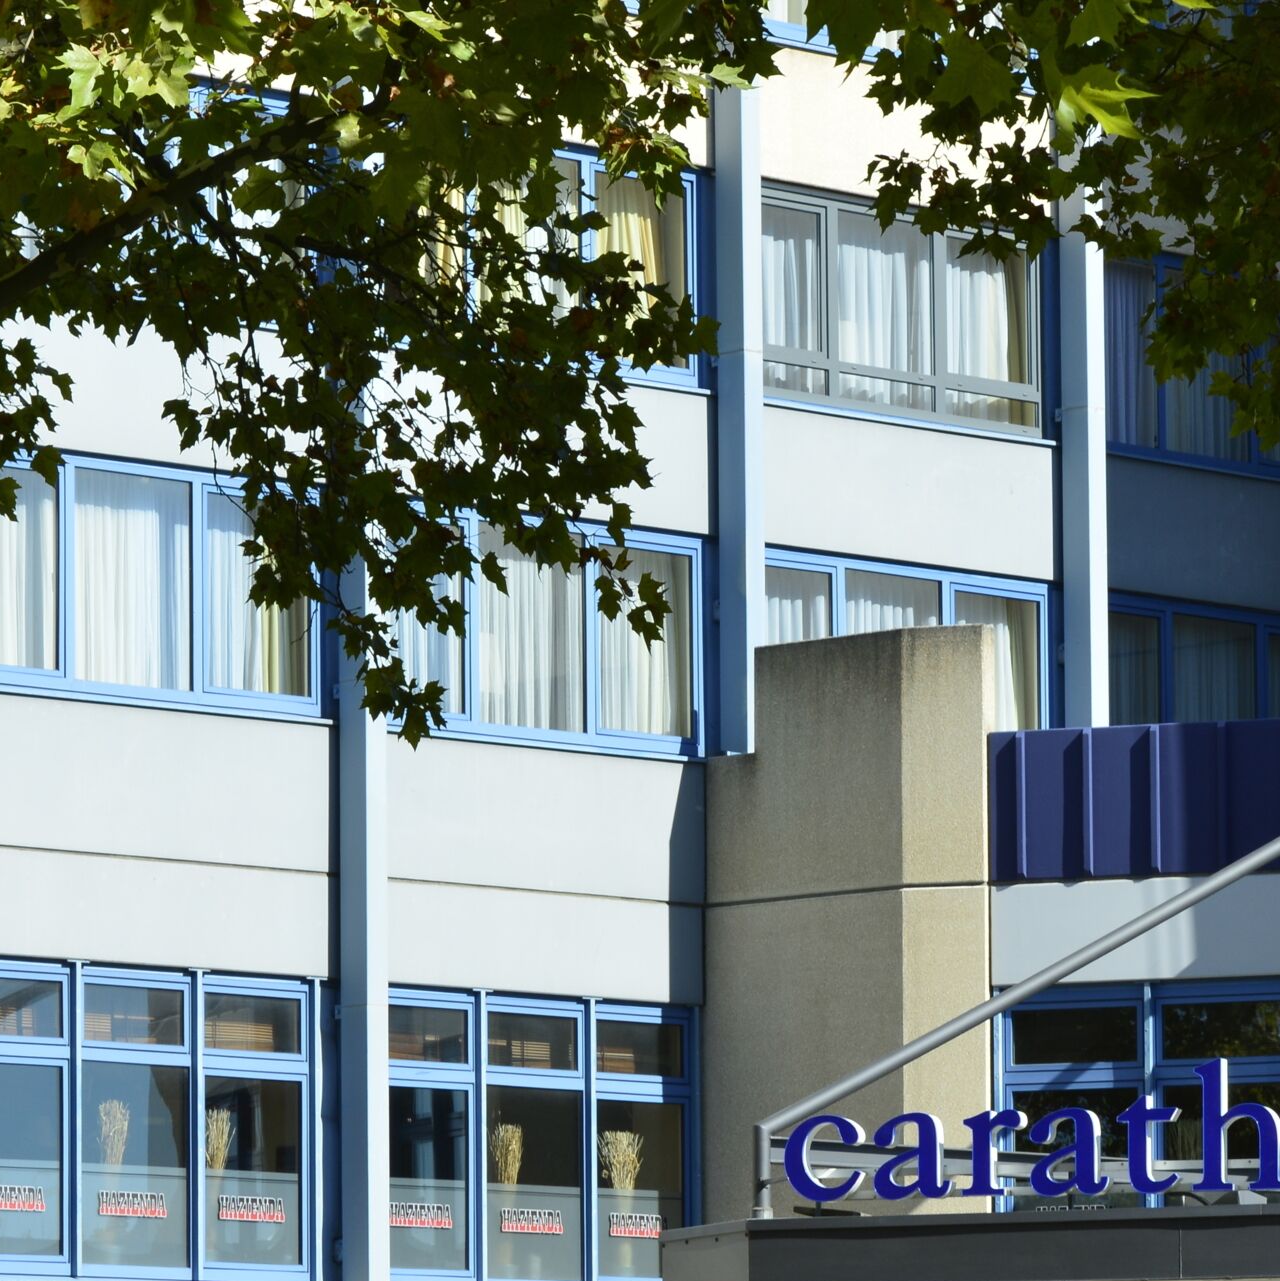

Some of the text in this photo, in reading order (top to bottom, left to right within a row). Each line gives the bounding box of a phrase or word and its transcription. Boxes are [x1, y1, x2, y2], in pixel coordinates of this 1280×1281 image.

[98, 1190, 168, 1218] HAZIENDA
[218, 1195, 286, 1223] HAZIENDA
[389, 1202, 453, 1229] HAZIENDA
[500, 1208, 564, 1235] HAZIENDA
